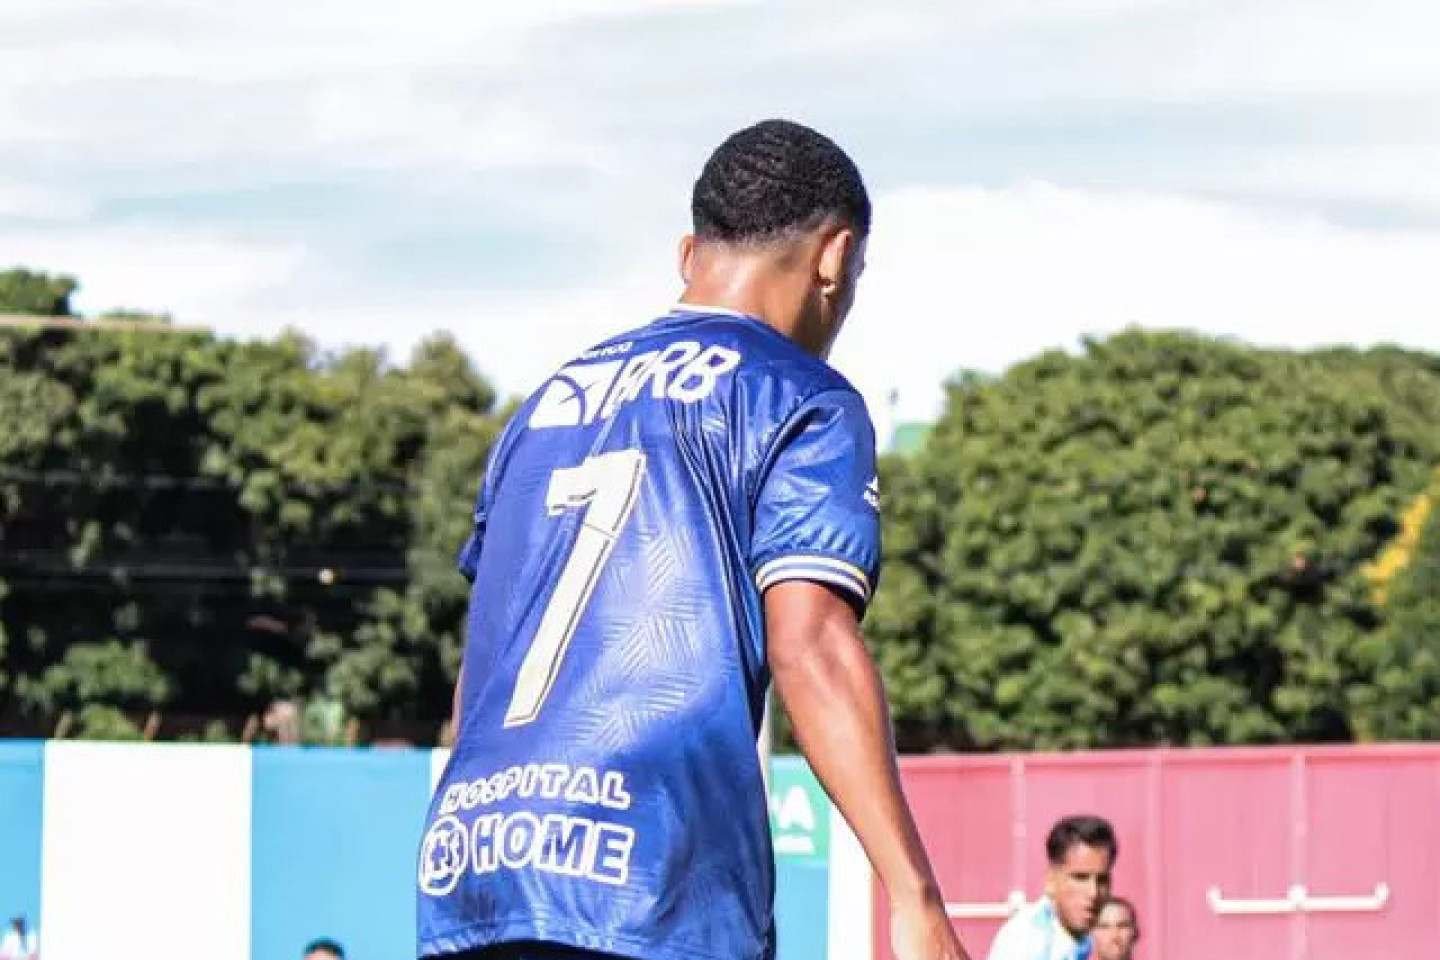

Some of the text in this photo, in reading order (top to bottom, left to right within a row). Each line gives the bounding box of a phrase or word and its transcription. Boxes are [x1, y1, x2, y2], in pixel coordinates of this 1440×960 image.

[503, 449, 646, 728] 7
[438, 763, 631, 816] HOSPITAL
[471, 811, 635, 886] HOME
